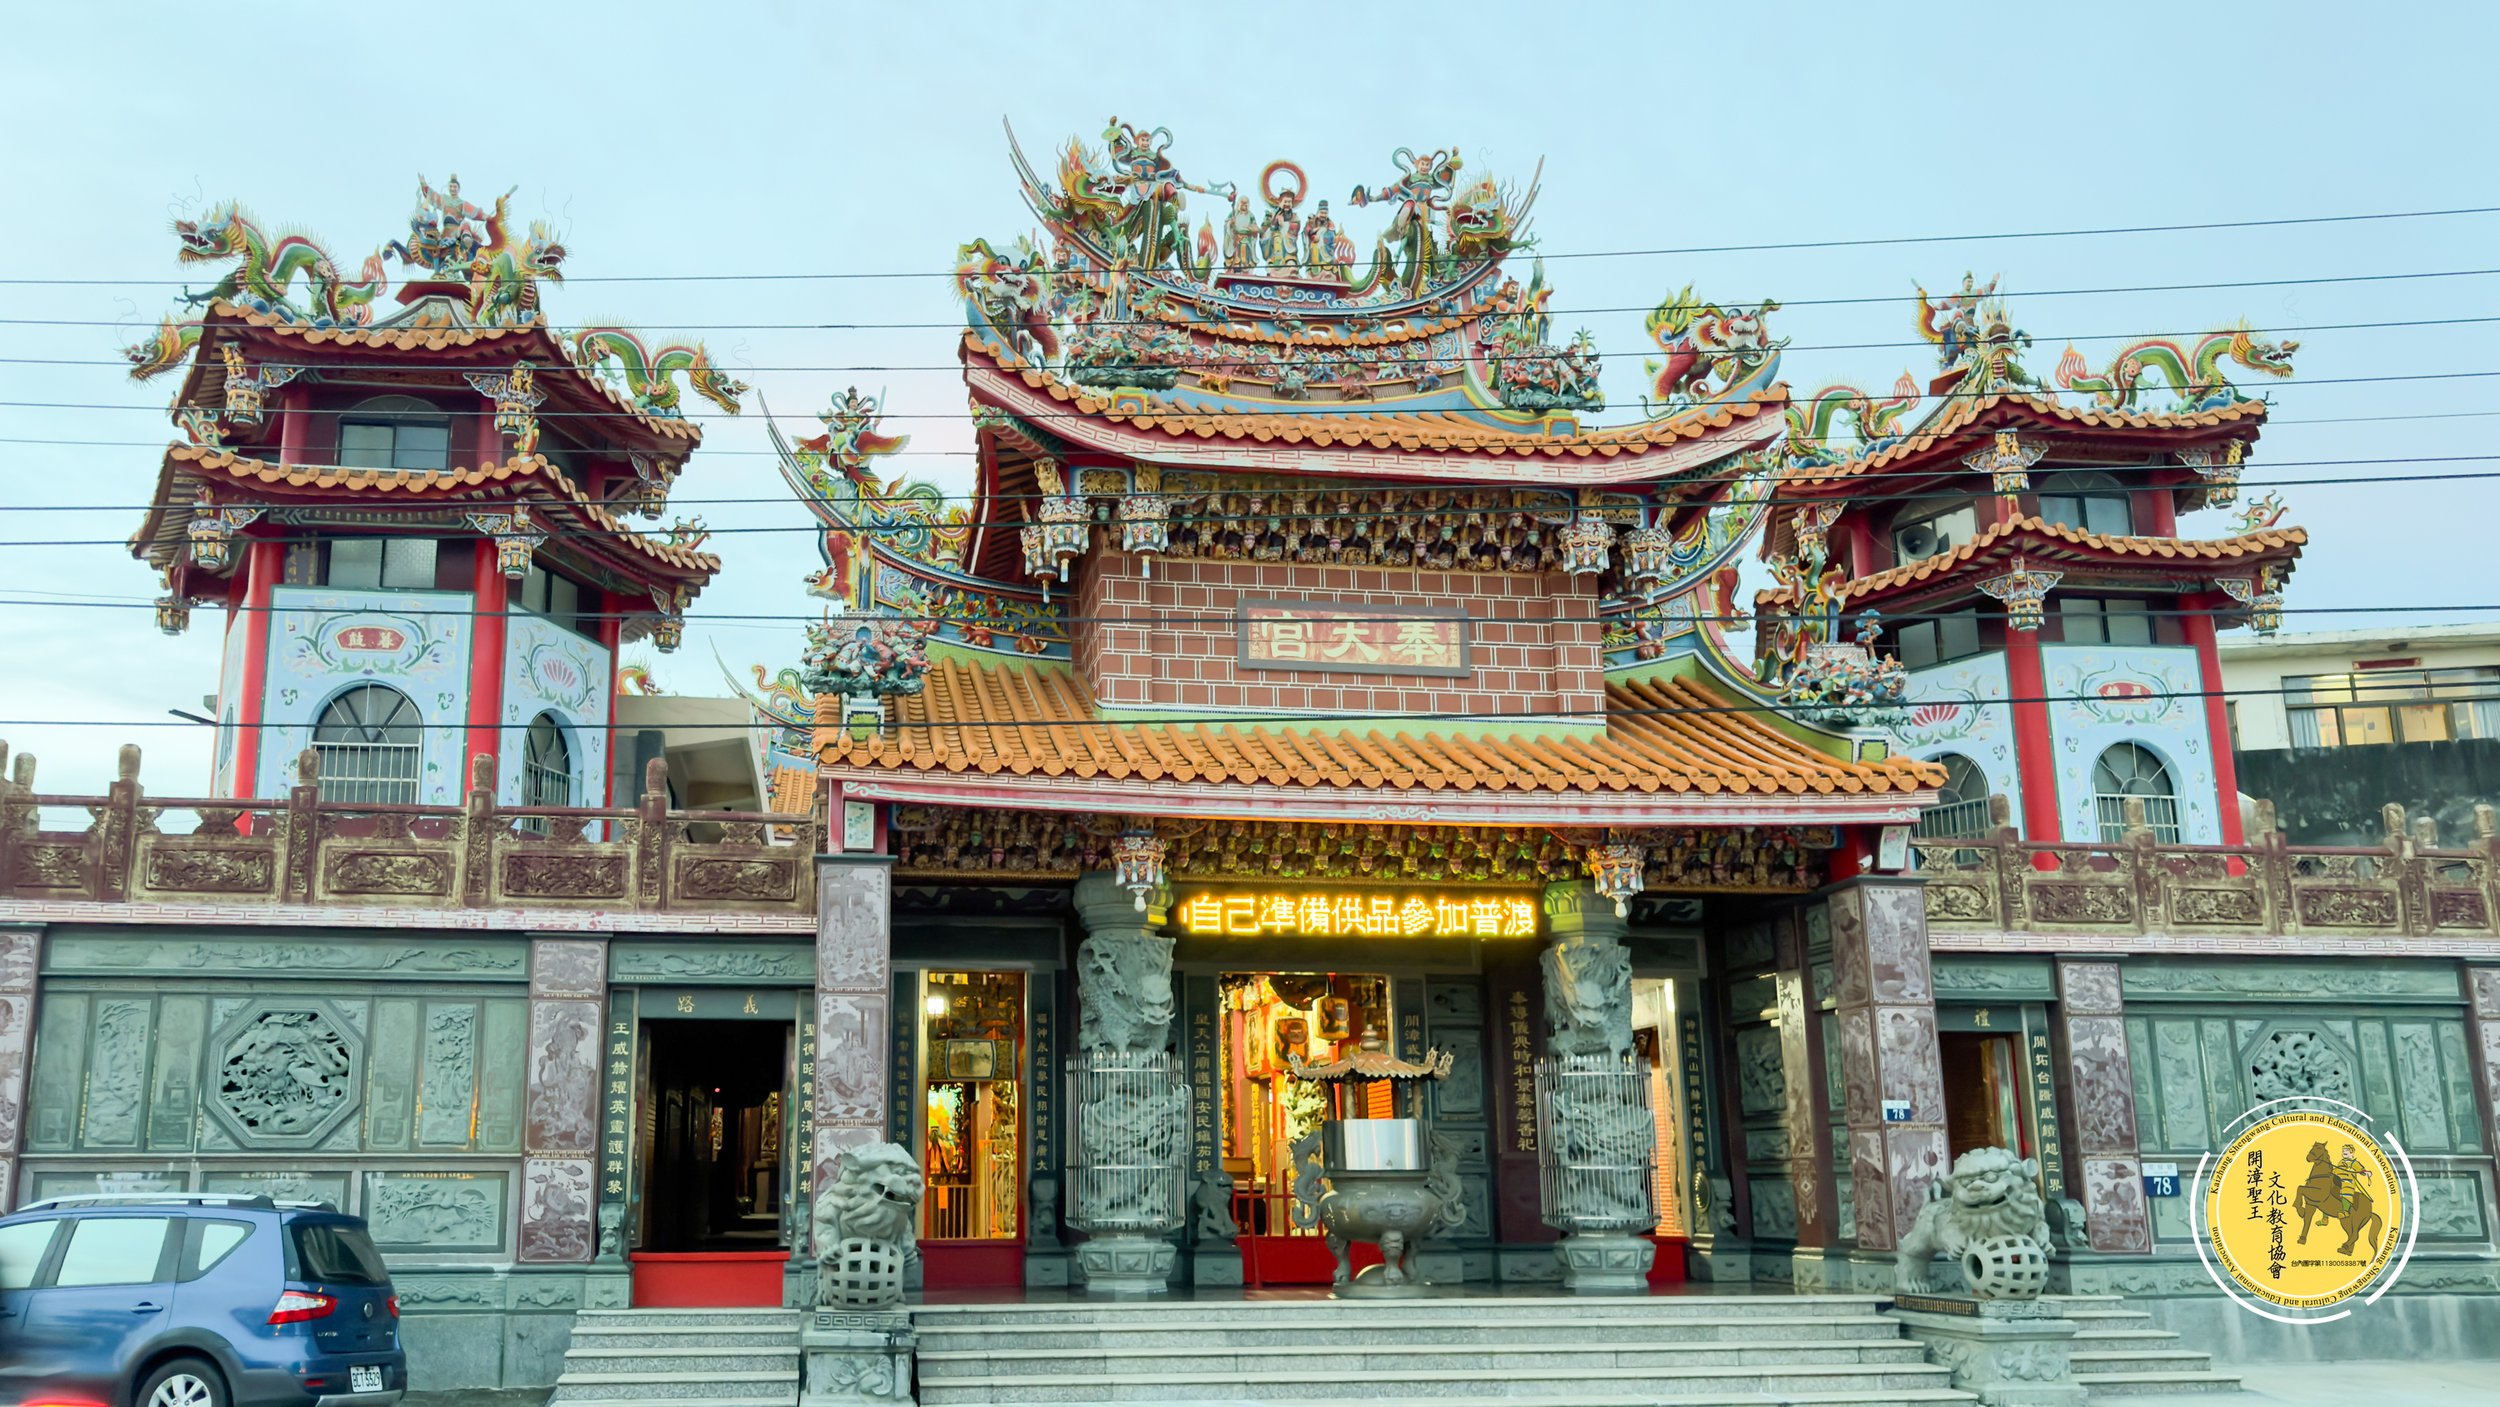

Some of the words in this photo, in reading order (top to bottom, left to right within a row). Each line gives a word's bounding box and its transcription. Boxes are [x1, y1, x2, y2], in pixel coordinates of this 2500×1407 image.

[1261, 610, 1447, 664] 奉天宮
[1189, 893, 1535, 935] 自己準備供品參加普渡
[1893, 1109, 1905, 1120] 78
[2153, 1176, 2172, 1195] 78
